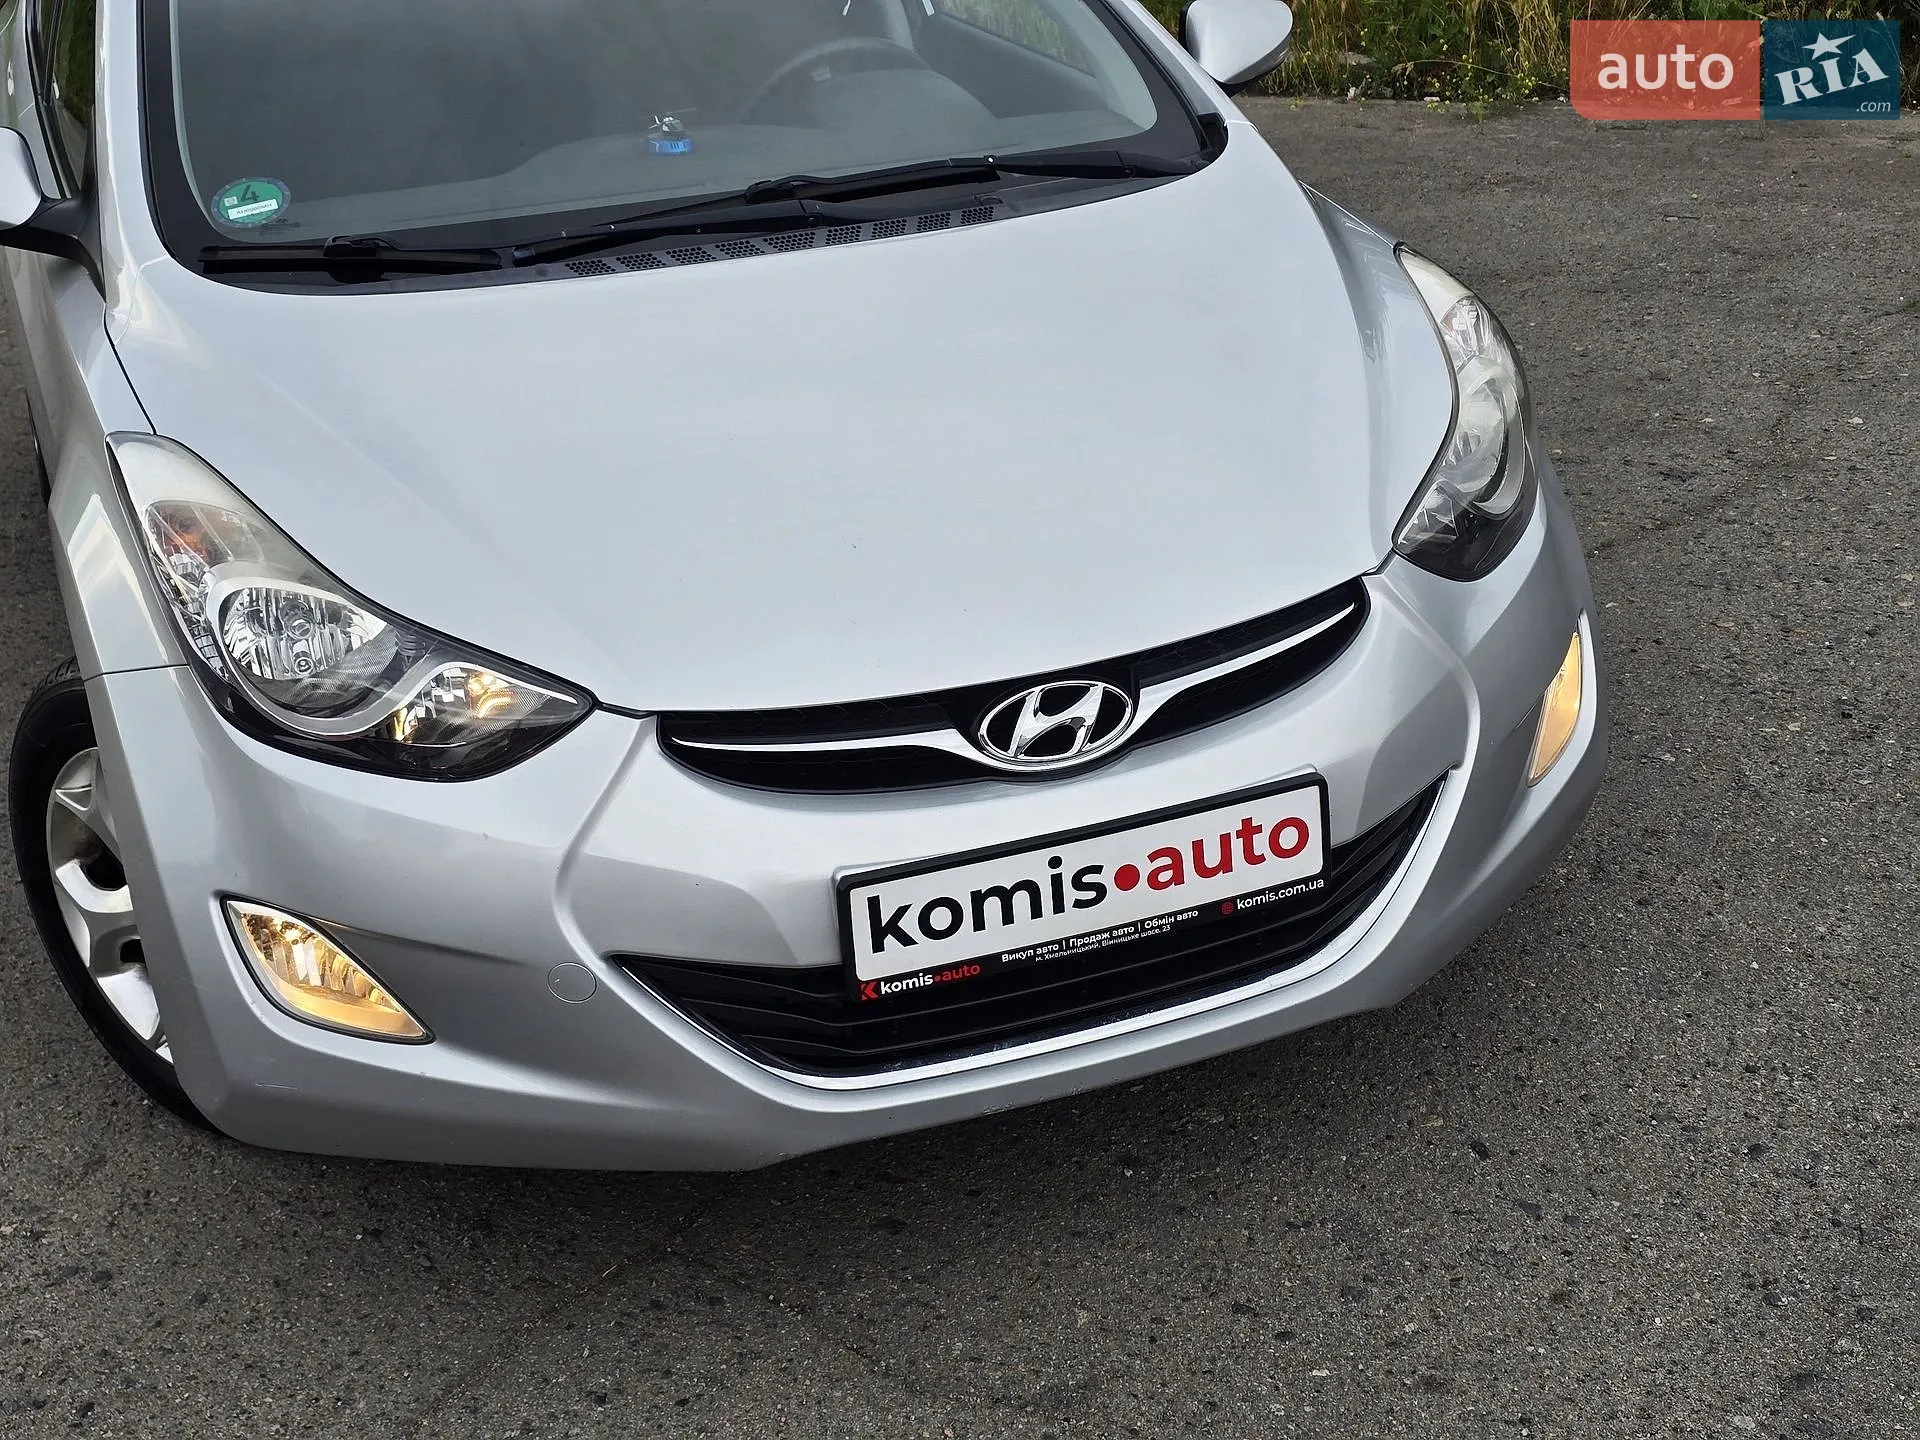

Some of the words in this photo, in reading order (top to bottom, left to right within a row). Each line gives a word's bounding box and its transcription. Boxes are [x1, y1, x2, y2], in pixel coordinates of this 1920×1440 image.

[1236, 878, 1325, 910] komis.com.ua
[1001, 949, 1034, 963] Викуп
[1036, 943, 1059, 955] авто
[1069, 933, 1110, 948] Продаж
[1112, 926, 1135, 937] авто
[1144, 915, 1175, 929] Обмін
[1176, 909, 1199, 921] авто
[1162, 924, 1171, 932] 23
